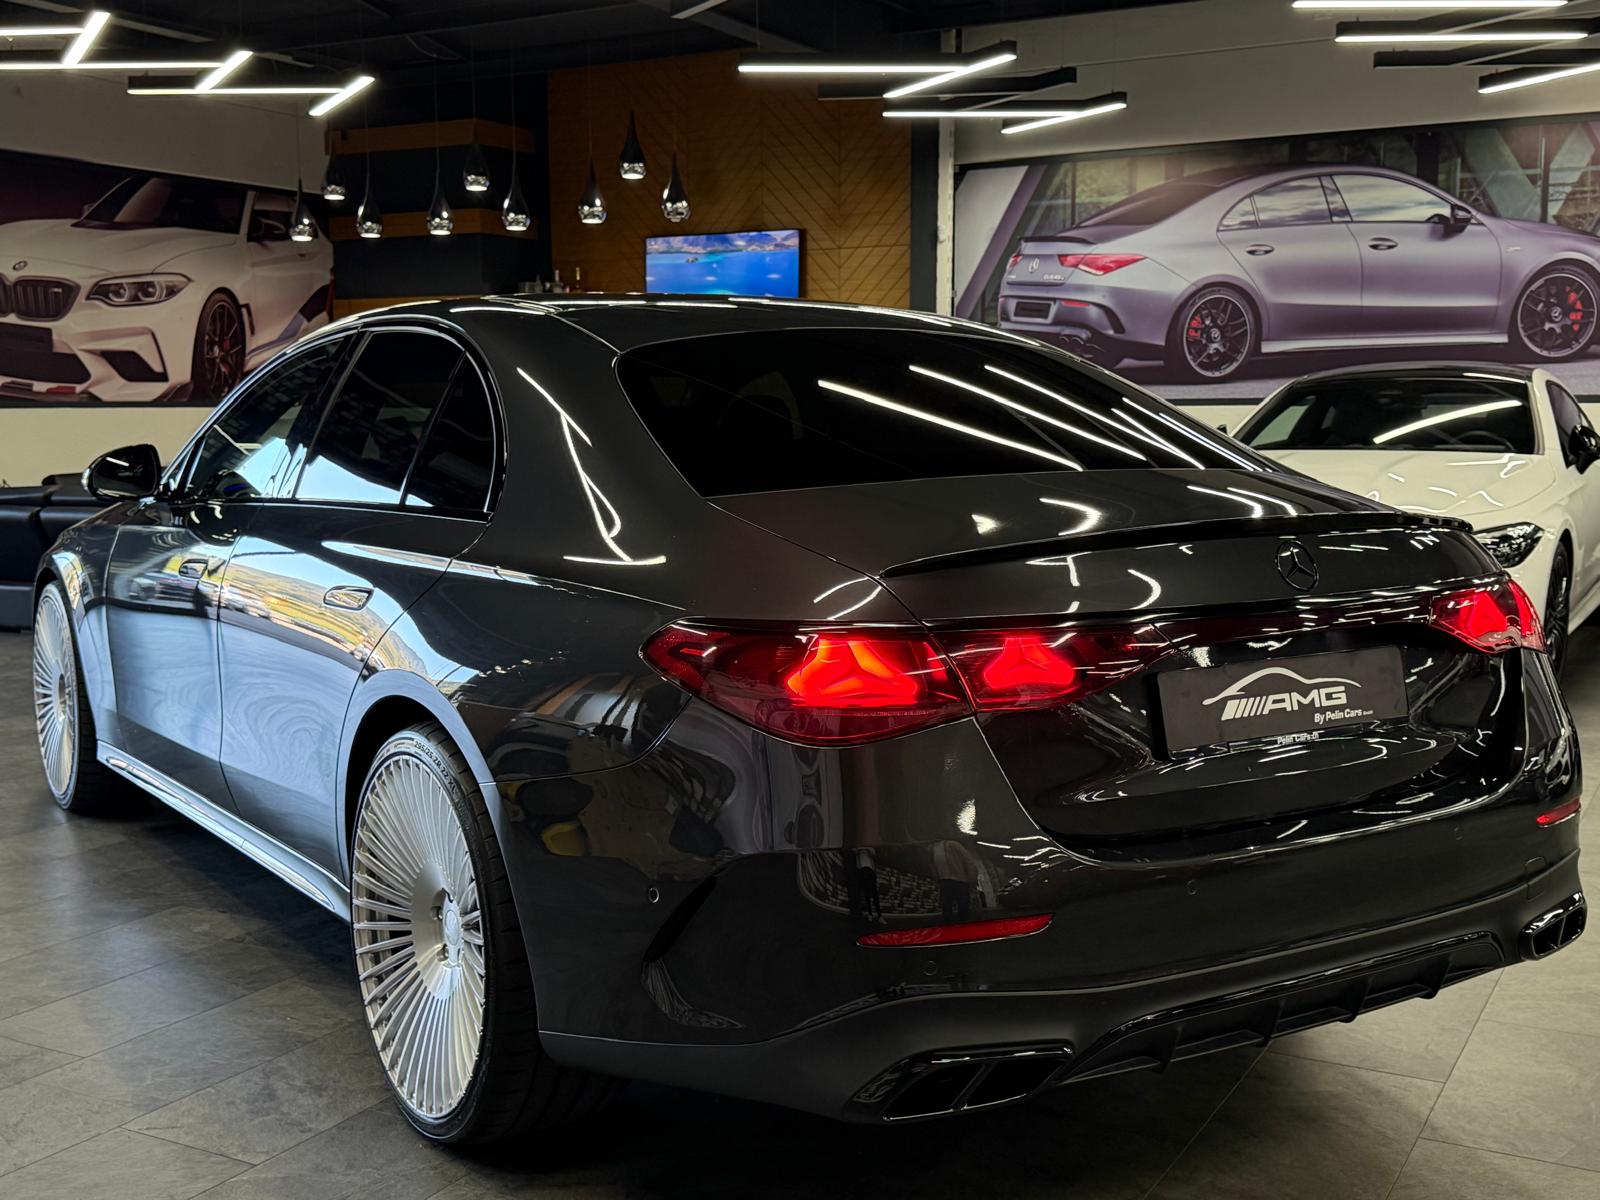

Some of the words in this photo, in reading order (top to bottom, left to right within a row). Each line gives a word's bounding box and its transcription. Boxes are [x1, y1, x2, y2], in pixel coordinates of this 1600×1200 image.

[1262, 685, 1347, 714] AMG
[1314, 712, 1325, 725] By
[1325, 710, 1344, 721] Pelin
[1344, 708, 1362, 718] Cars
